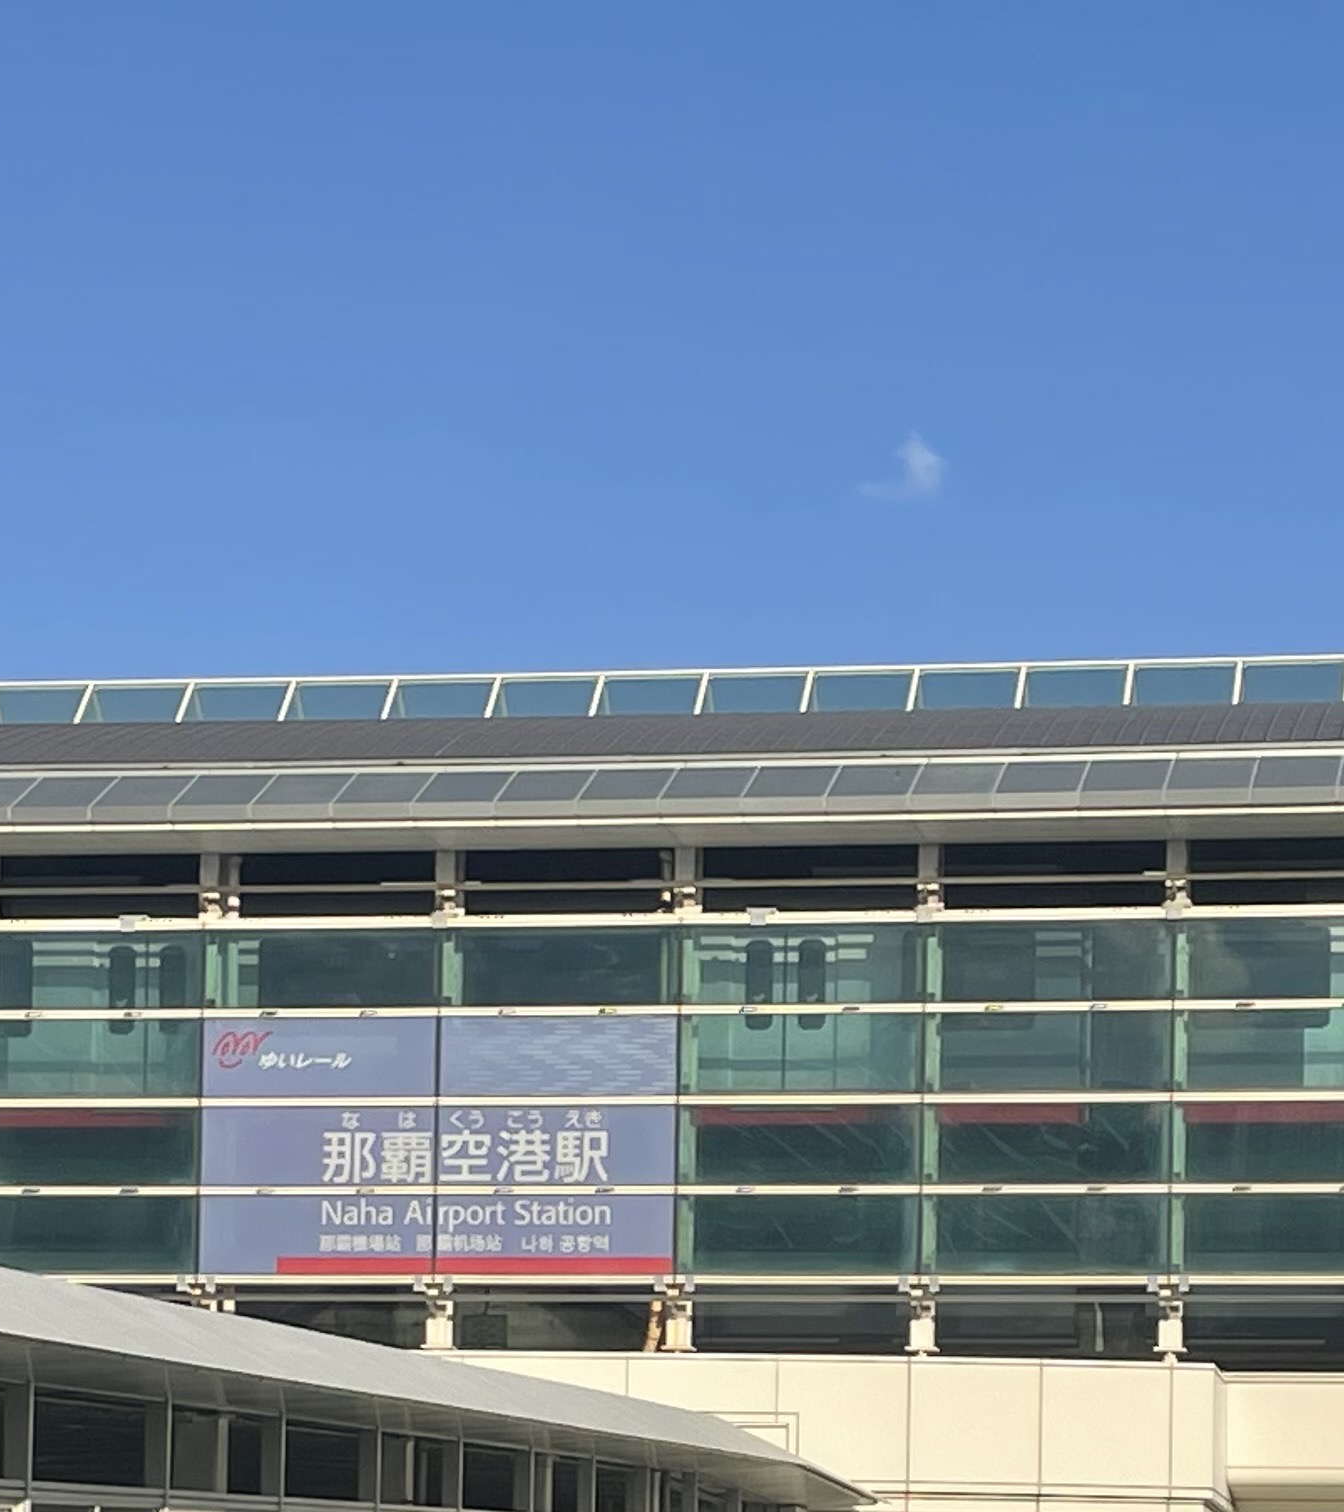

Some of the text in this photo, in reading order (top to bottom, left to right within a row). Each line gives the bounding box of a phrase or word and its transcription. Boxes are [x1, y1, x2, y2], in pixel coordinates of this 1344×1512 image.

[258, 1051, 353, 1070] ゆいレール
[341, 1110, 603, 1129] な は くう こう えき
[322, 1129, 609, 1183] 那覇空港駅
[321, 1197, 612, 1232] Naha Airport Station
